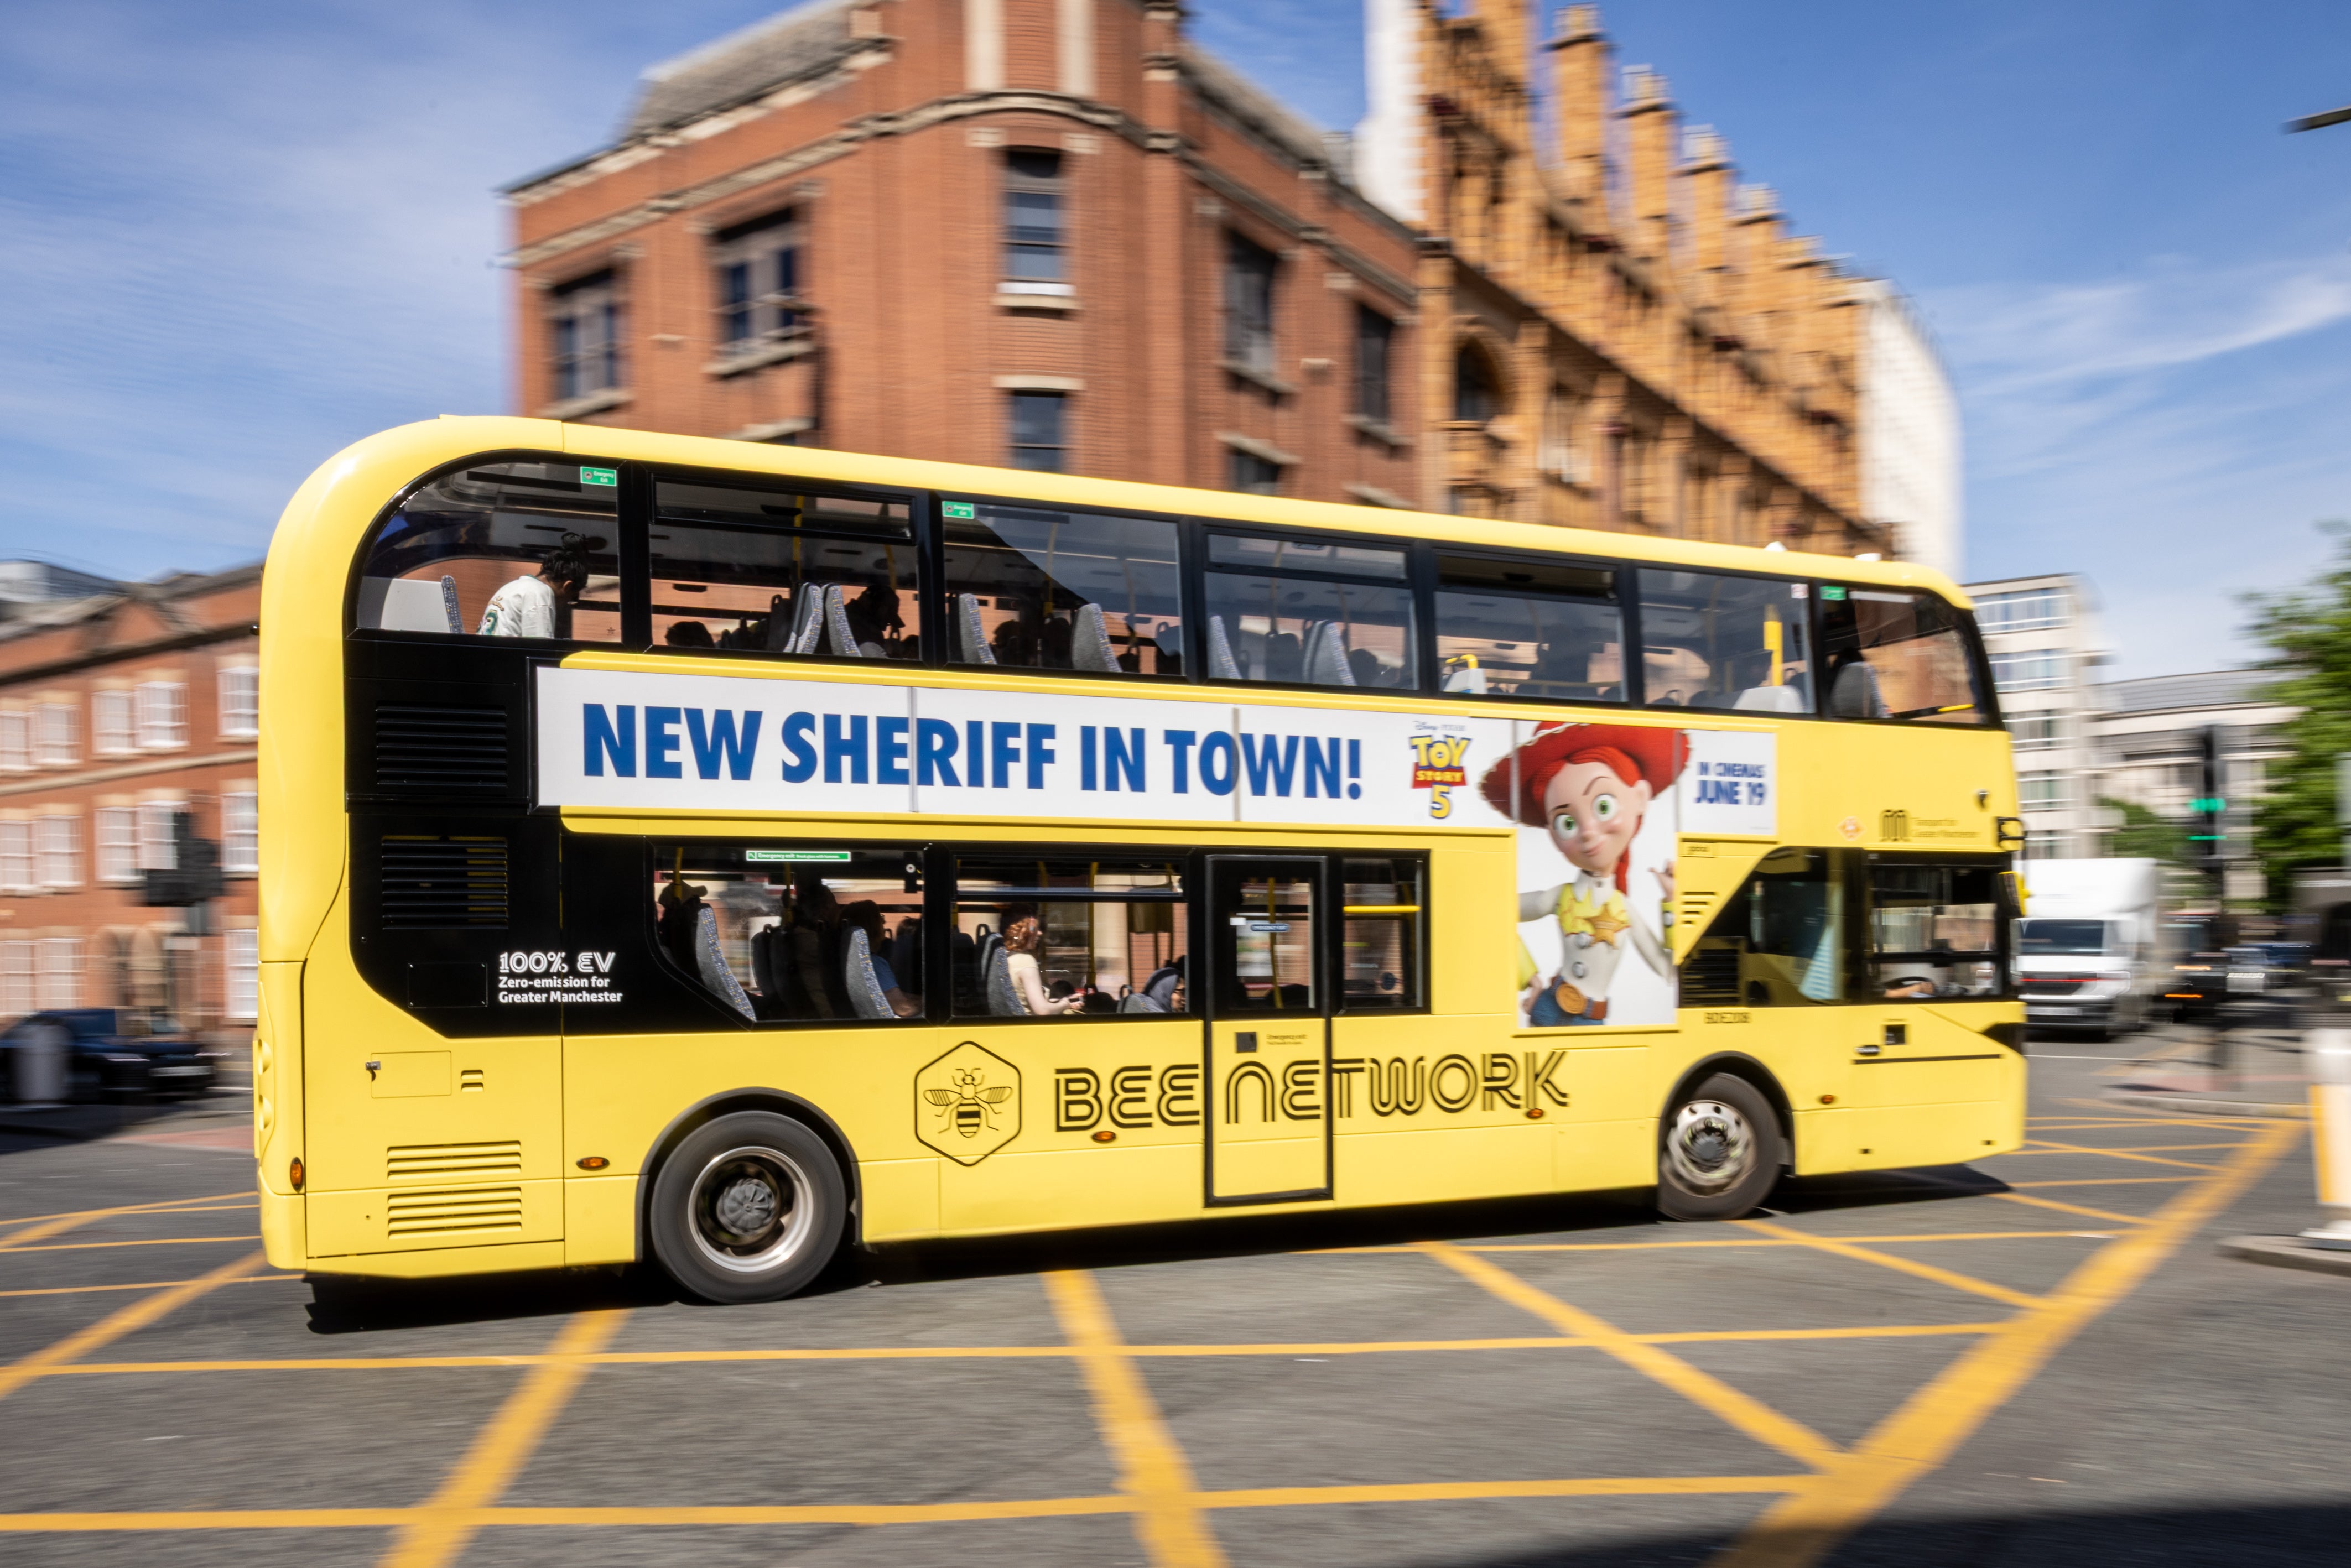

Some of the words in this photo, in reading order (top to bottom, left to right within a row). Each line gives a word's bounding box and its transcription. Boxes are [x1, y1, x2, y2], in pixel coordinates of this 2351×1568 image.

[584, 704, 762, 780] NEW
[782, 711, 1055, 789] SHERIFF
[1081, 726, 1146, 792] IN
[1164, 730, 1361, 800] TOWN!
[1409, 735, 1471, 770] TOY
[1416, 770, 1463, 782] STORY
[1431, 783, 1452, 820] 5
[1694, 780, 1741, 805] JUNE
[1745, 782, 1767, 806] 19
[499, 951, 569, 973] 100%
[576, 952, 616, 973] EV
[498, 976, 589, 988] Zero-emission
[590, 976, 611, 988] for
[498, 991, 548, 1003] Greater
[549, 990, 623, 1003] Manchester
[1055, 1063, 1199, 1132] BEE
